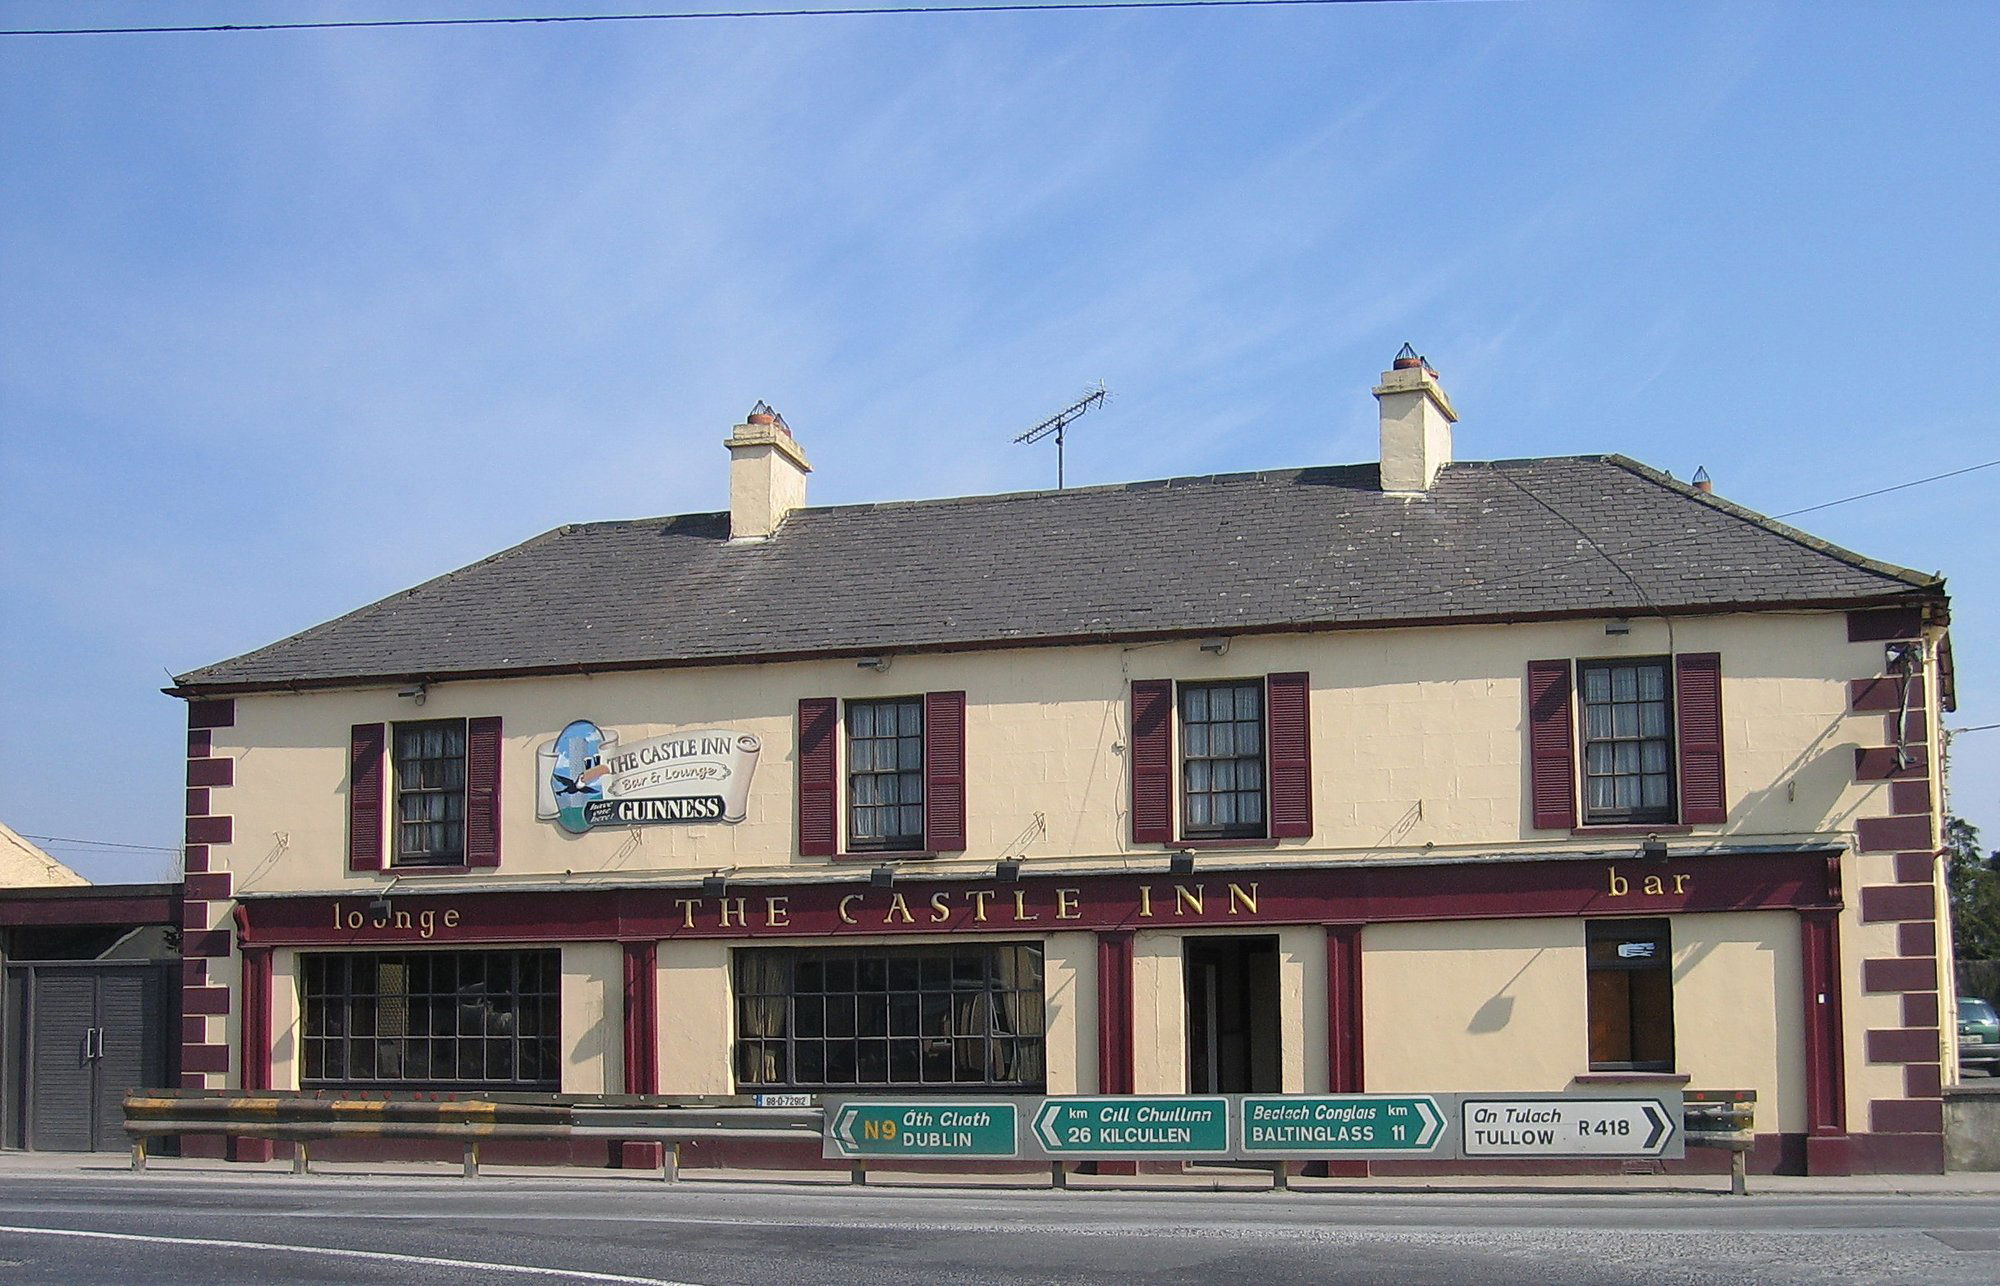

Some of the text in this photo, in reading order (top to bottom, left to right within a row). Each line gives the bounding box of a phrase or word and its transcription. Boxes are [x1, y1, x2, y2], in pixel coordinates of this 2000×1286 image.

[607, 737, 732, 775] THE CASTLE INN
[622, 766, 718, 791] Bar & Lounge
[618, 798, 720, 820] GUINNESS
[1608, 866, 1691, 897] bar
[675, 882, 1259, 928] THE CASTLE INN
[1069, 1107, 1088, 1119] km
[1100, 1107, 1129, 1122] Cill
[1253, 1104, 1377, 1123] Bealach Conglais
[1387, 1104, 1408, 1116] km
[1474, 1108, 1562, 1123] An Tulach
[940, 1111, 990, 1126] Cliath
[864, 1120, 897, 1140] N9
[1068, 1127, 1092, 1143] 26
[1100, 1127, 1191, 1143] KILCULLEN
[1252, 1126, 1374, 1141] BALTINGLASS
[1391, 1125, 1406, 1141] 11
[1578, 1119, 1630, 1136] R 418
[903, 1132, 972, 1147] DUBLIN
[1474, 1130, 1555, 1145] TULLOW
